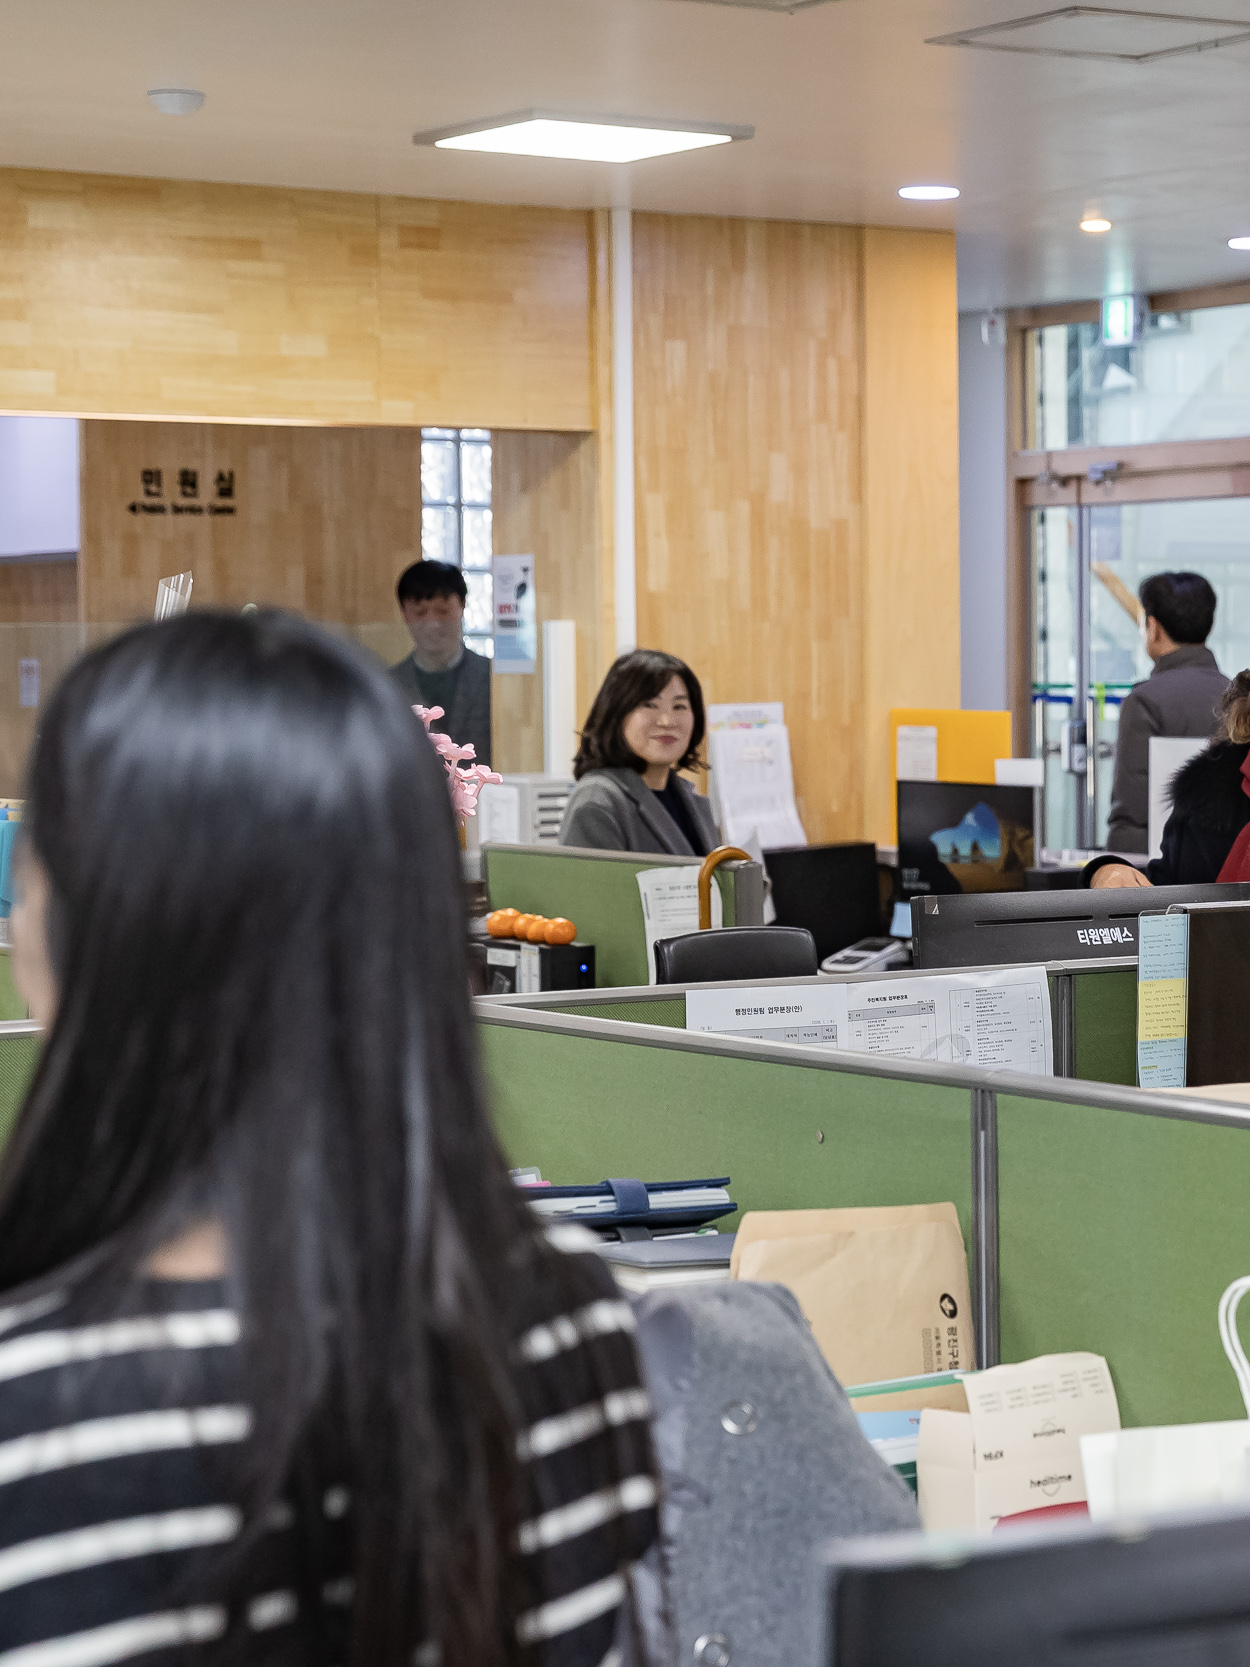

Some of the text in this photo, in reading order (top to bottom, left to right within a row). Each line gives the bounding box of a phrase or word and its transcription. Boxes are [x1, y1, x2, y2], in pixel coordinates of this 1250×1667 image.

[1077, 926, 1134, 946] 티원엘에스
[734, 1004, 803, 1016] 행정민원팀 업무분장(안)
